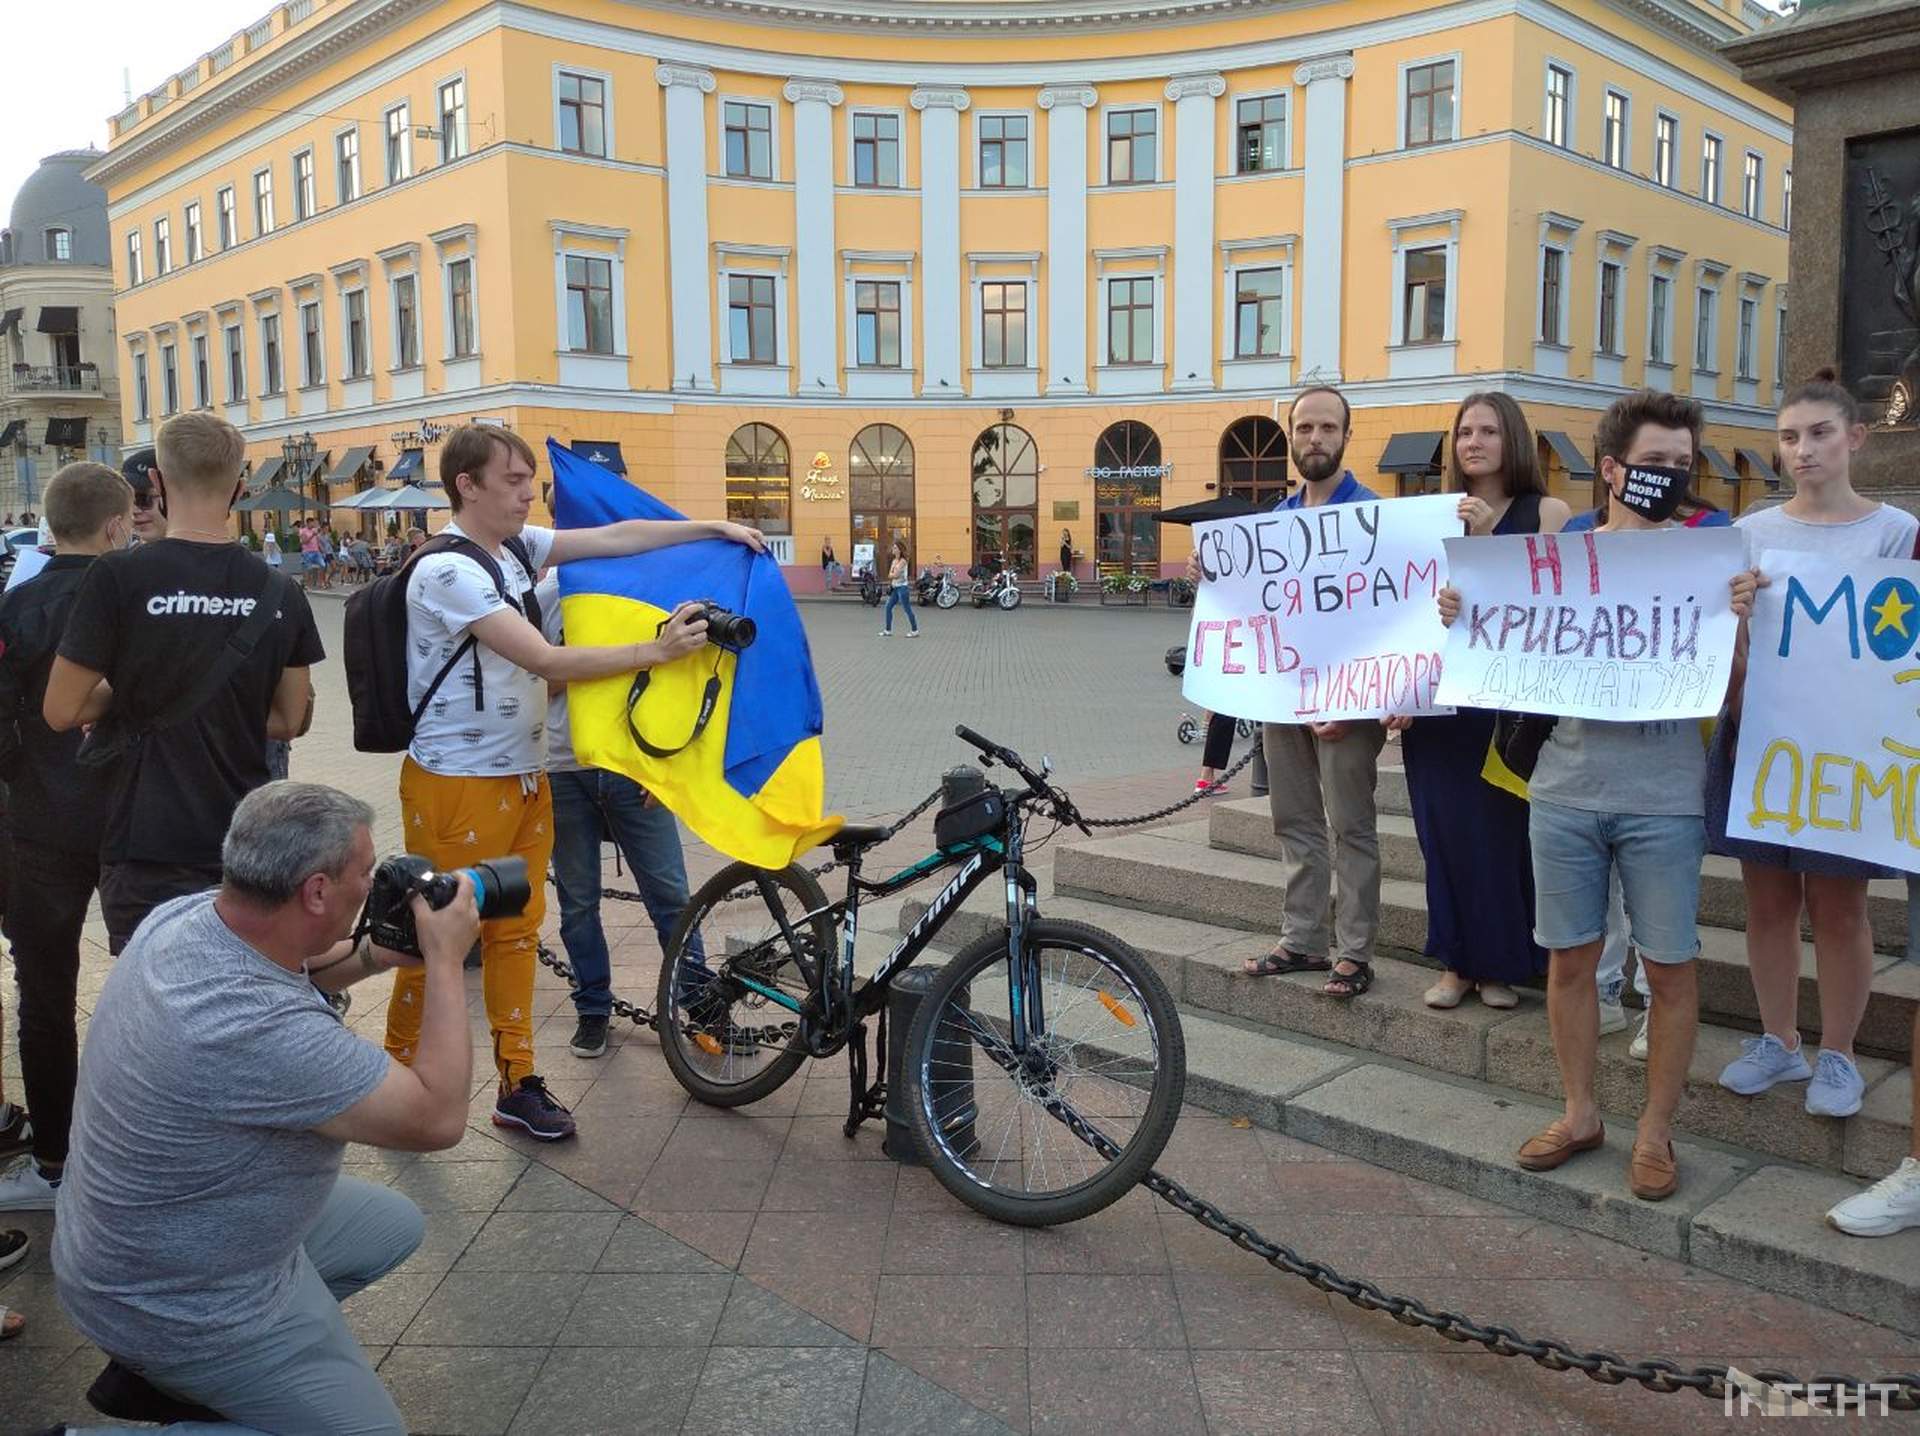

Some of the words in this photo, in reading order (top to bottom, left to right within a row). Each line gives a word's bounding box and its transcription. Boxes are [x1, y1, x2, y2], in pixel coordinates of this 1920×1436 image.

[1120, 462, 1174, 480] FACTORY
[1623, 493, 1651, 509] ВІРА
[1626, 481, 1663, 498] МОВА
[1629, 469, 1672, 487] АРМІЯ
[1199, 504, 1380, 583] СВОБОДУ
[1524, 532, 1601, 596] НІ
[1262, 557, 1438, 617] СЯБРАМ
[1193, 614, 1301, 675] ГЕТЬ
[1778, 574, 1920, 661] МО
